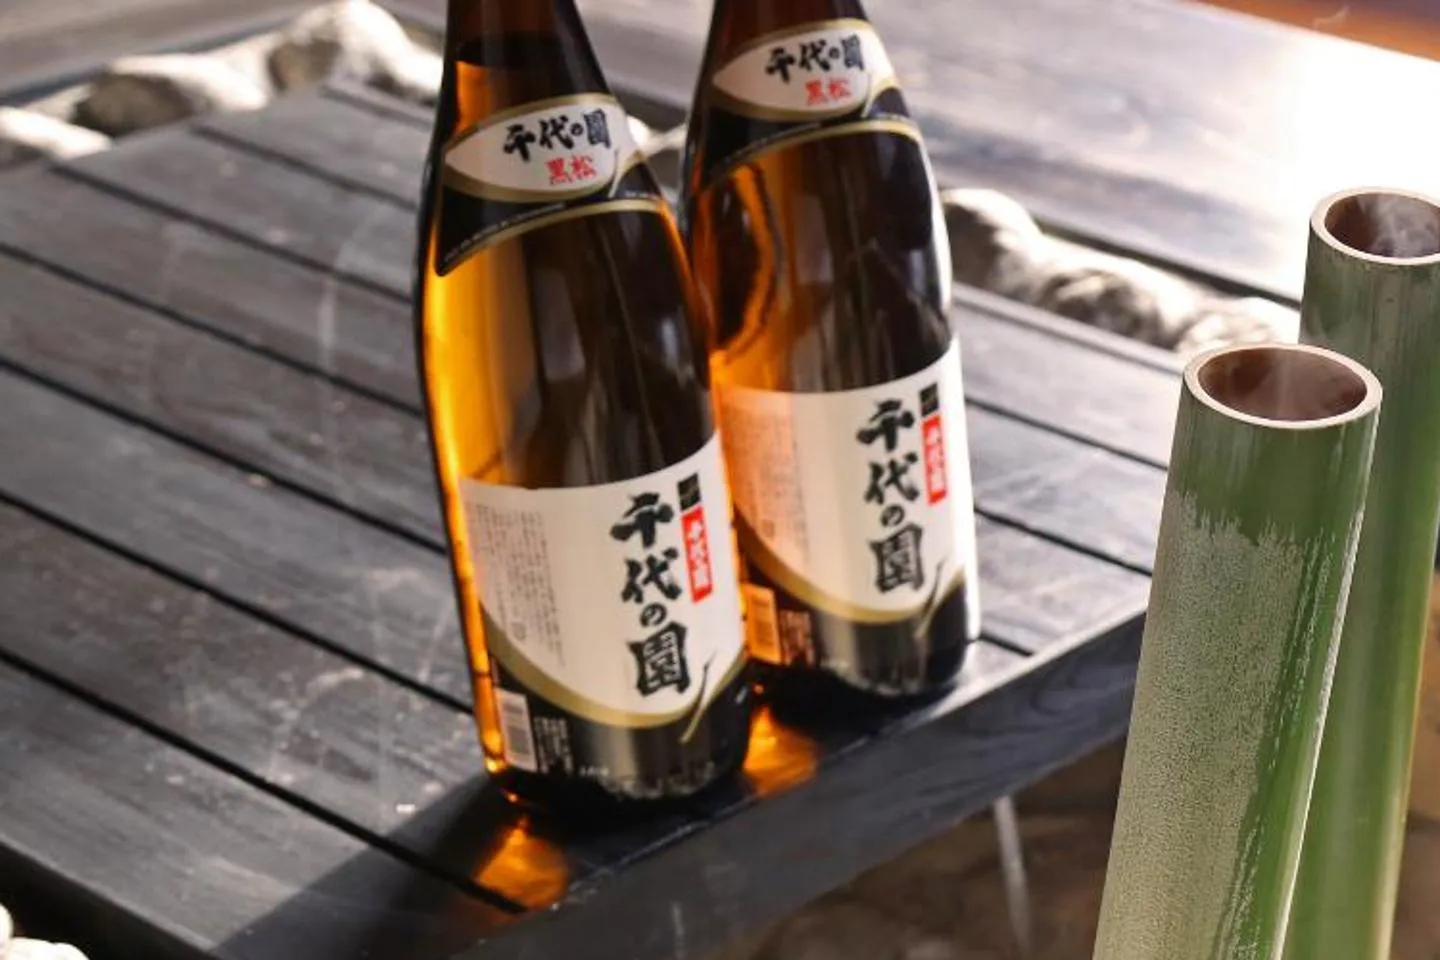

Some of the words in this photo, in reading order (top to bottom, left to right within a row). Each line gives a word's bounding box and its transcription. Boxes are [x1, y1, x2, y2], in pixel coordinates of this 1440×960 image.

[503, 108, 611, 162] 千代の園
[545, 155, 597, 185] 黒松
[856, 398, 924, 593] 千代の園
[609, 491, 691, 697] 千代の園
